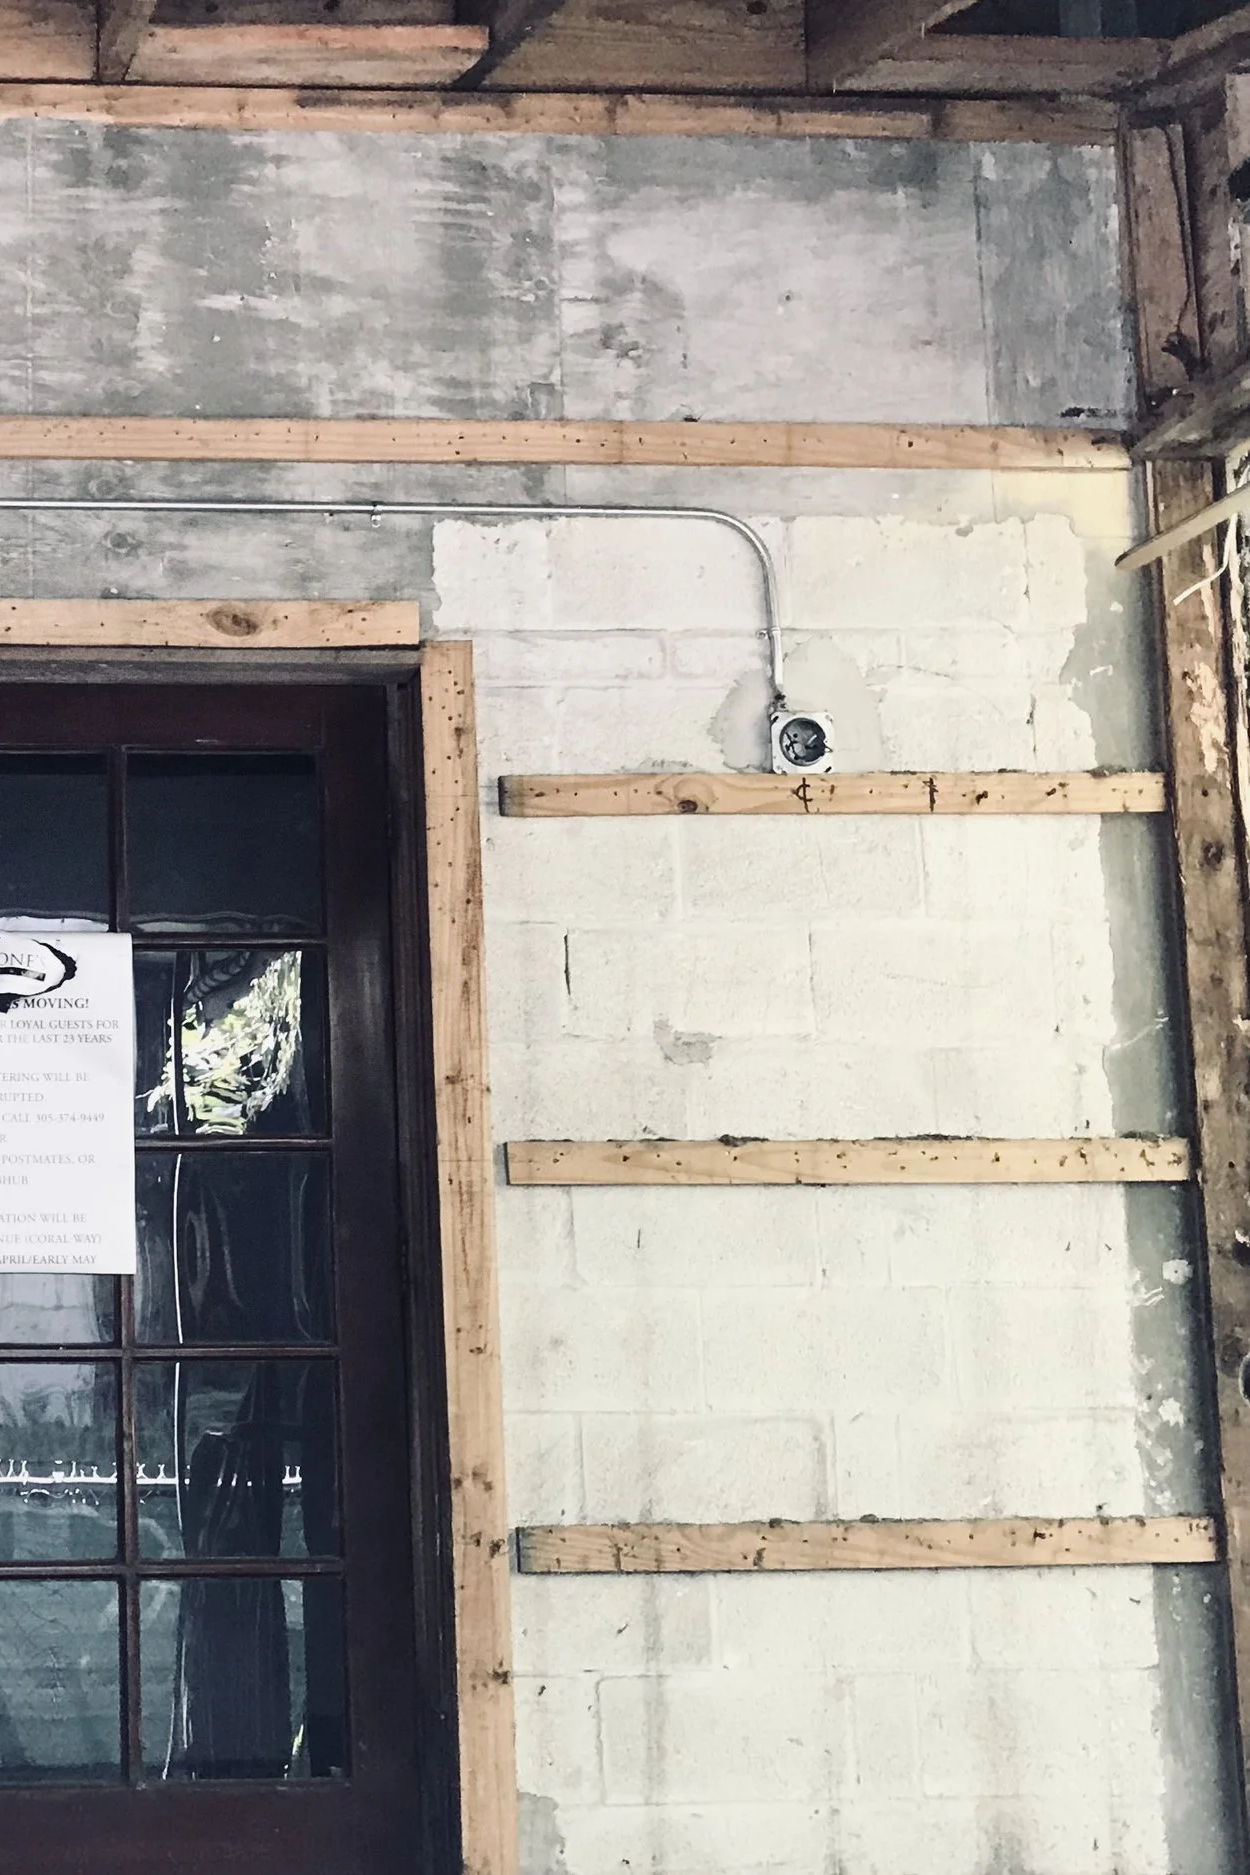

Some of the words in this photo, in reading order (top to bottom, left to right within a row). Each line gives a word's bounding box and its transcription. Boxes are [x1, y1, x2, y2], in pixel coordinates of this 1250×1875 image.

[23, 997, 89, 1009] MOVING!
[10, 1020, 46, 1029] LOYAL
[49, 1020, 93, 1029] GUESTS
[96, 1020, 119, 1029] FOR
[7, 1034, 29, 1043] THE
[32, 1034, 60, 1043] LAST
[62, 1034, 75, 1043] 23
[77, 1034, 113, 1043] YEARS
[42, 1072, 73, 1082] WILL
[75, 1072, 90, 1082] BE
[1, 1113, 30, 1123] CALL
[36, 1113, 105, 1123] 305-374-9449
[77, 1154, 96, 1165] OR
[39, 1214, 69, 1223] WILL
[72, 1214, 87, 1223] BE
[73, 1234, 102, 1245] WAY)
[71, 1255, 97, 1265] MAY
